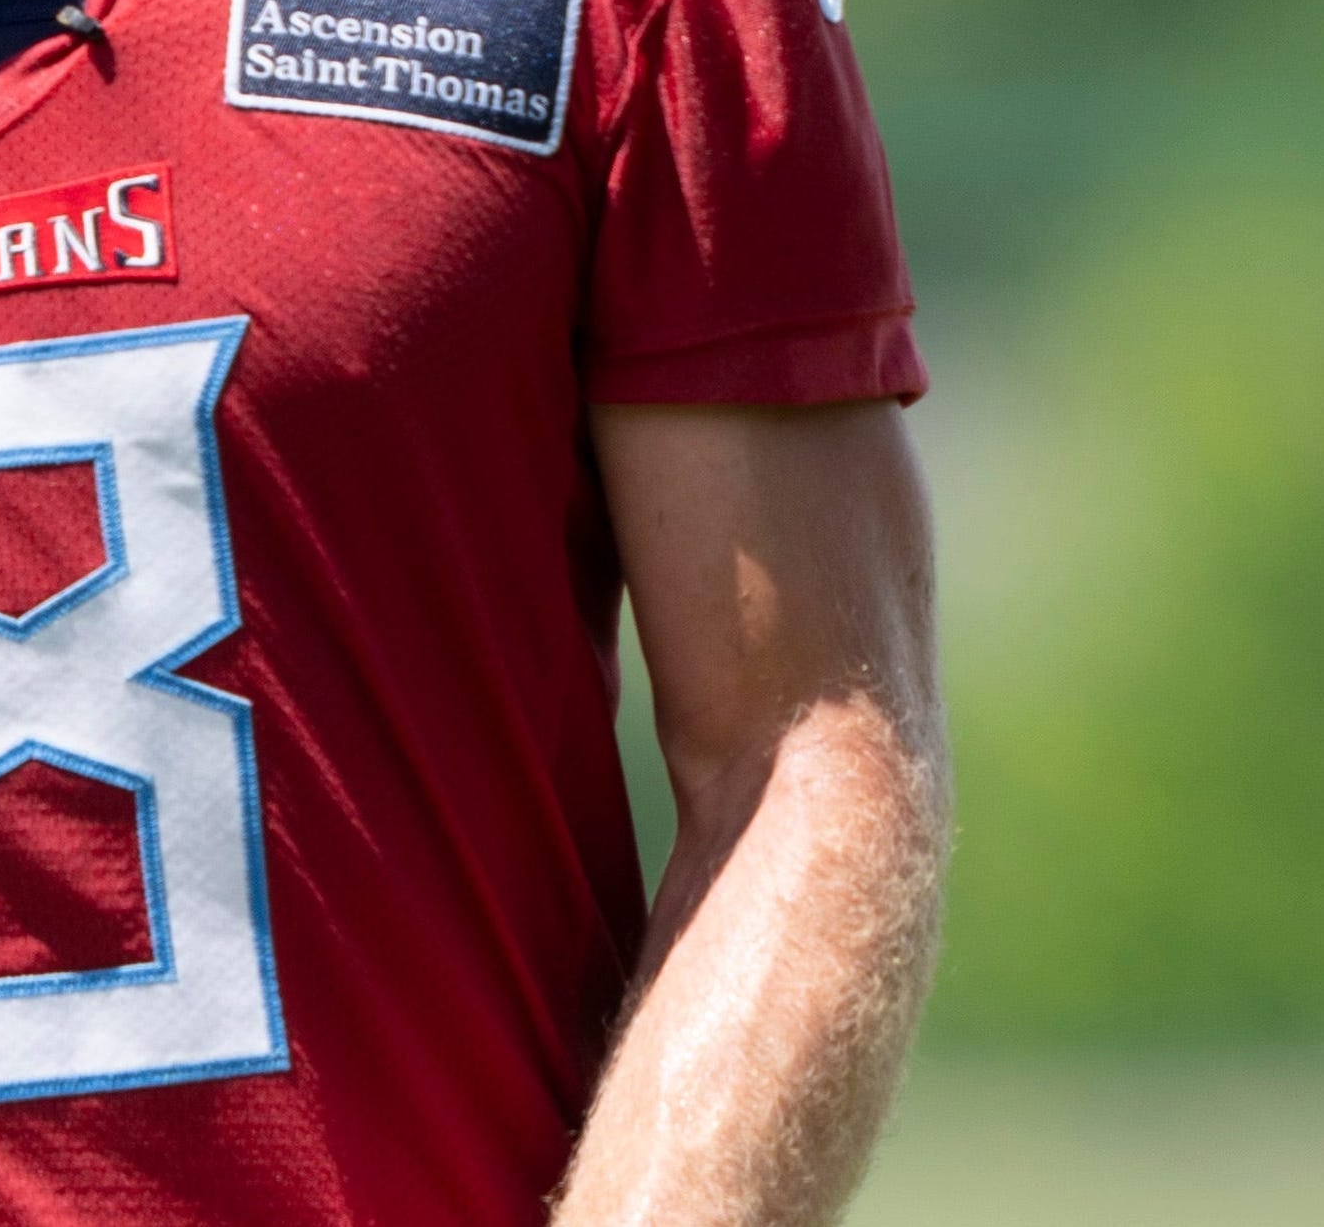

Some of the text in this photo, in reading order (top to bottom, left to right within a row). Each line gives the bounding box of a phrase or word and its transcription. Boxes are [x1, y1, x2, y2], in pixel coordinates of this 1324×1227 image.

[251, 0, 484, 59] Ascension
[245, 43, 551, 121] Saint Thomas
